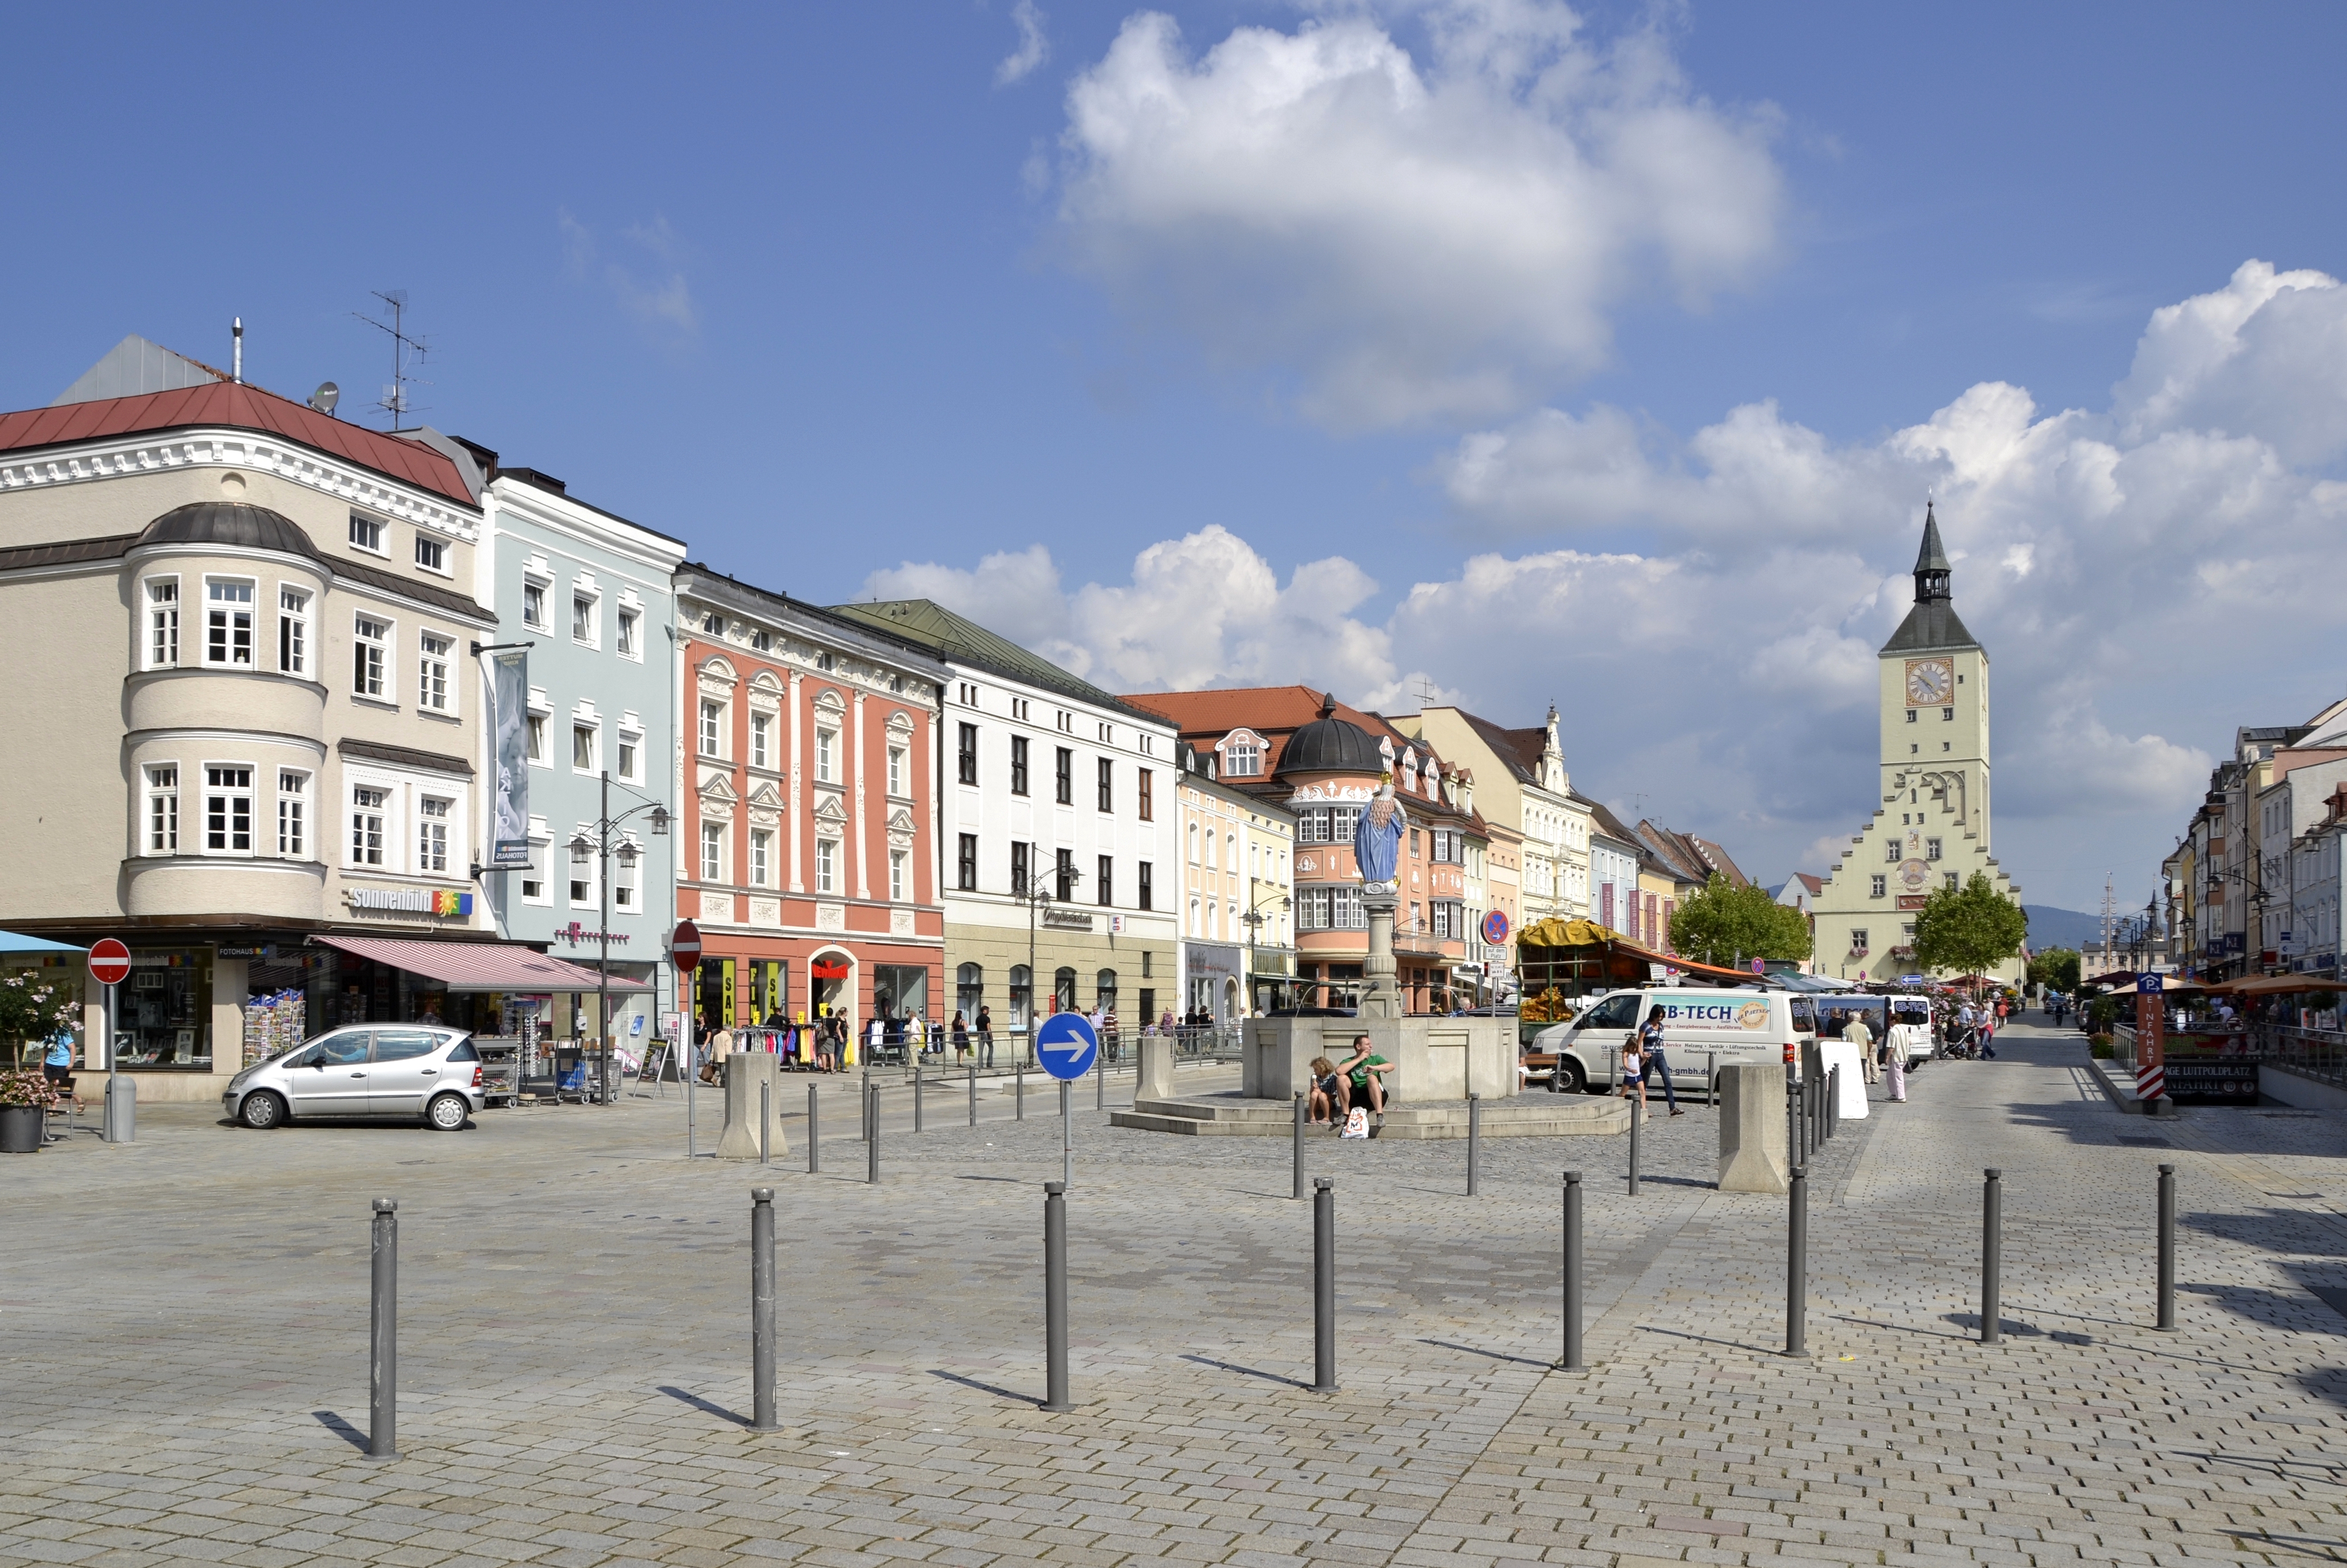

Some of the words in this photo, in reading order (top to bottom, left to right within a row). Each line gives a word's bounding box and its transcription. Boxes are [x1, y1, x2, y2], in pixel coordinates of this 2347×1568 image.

[353, 888, 432, 912] sonnenbild
[1050, 909, 1092, 924] HypoVereinsbank
[131, 956, 169, 966] onnenbild
[2146, 980, 2155, 990] P
[1896, 1002, 1927, 1012] GB-TECH
[2146, 996, 2154, 1063] EINFAHRT
[2164, 1067, 2180, 1075] AGE
[2183, 1067, 2250, 1076] LUITPOLDPLATZ
[2163, 1079, 2218, 1089] INFAHRT
